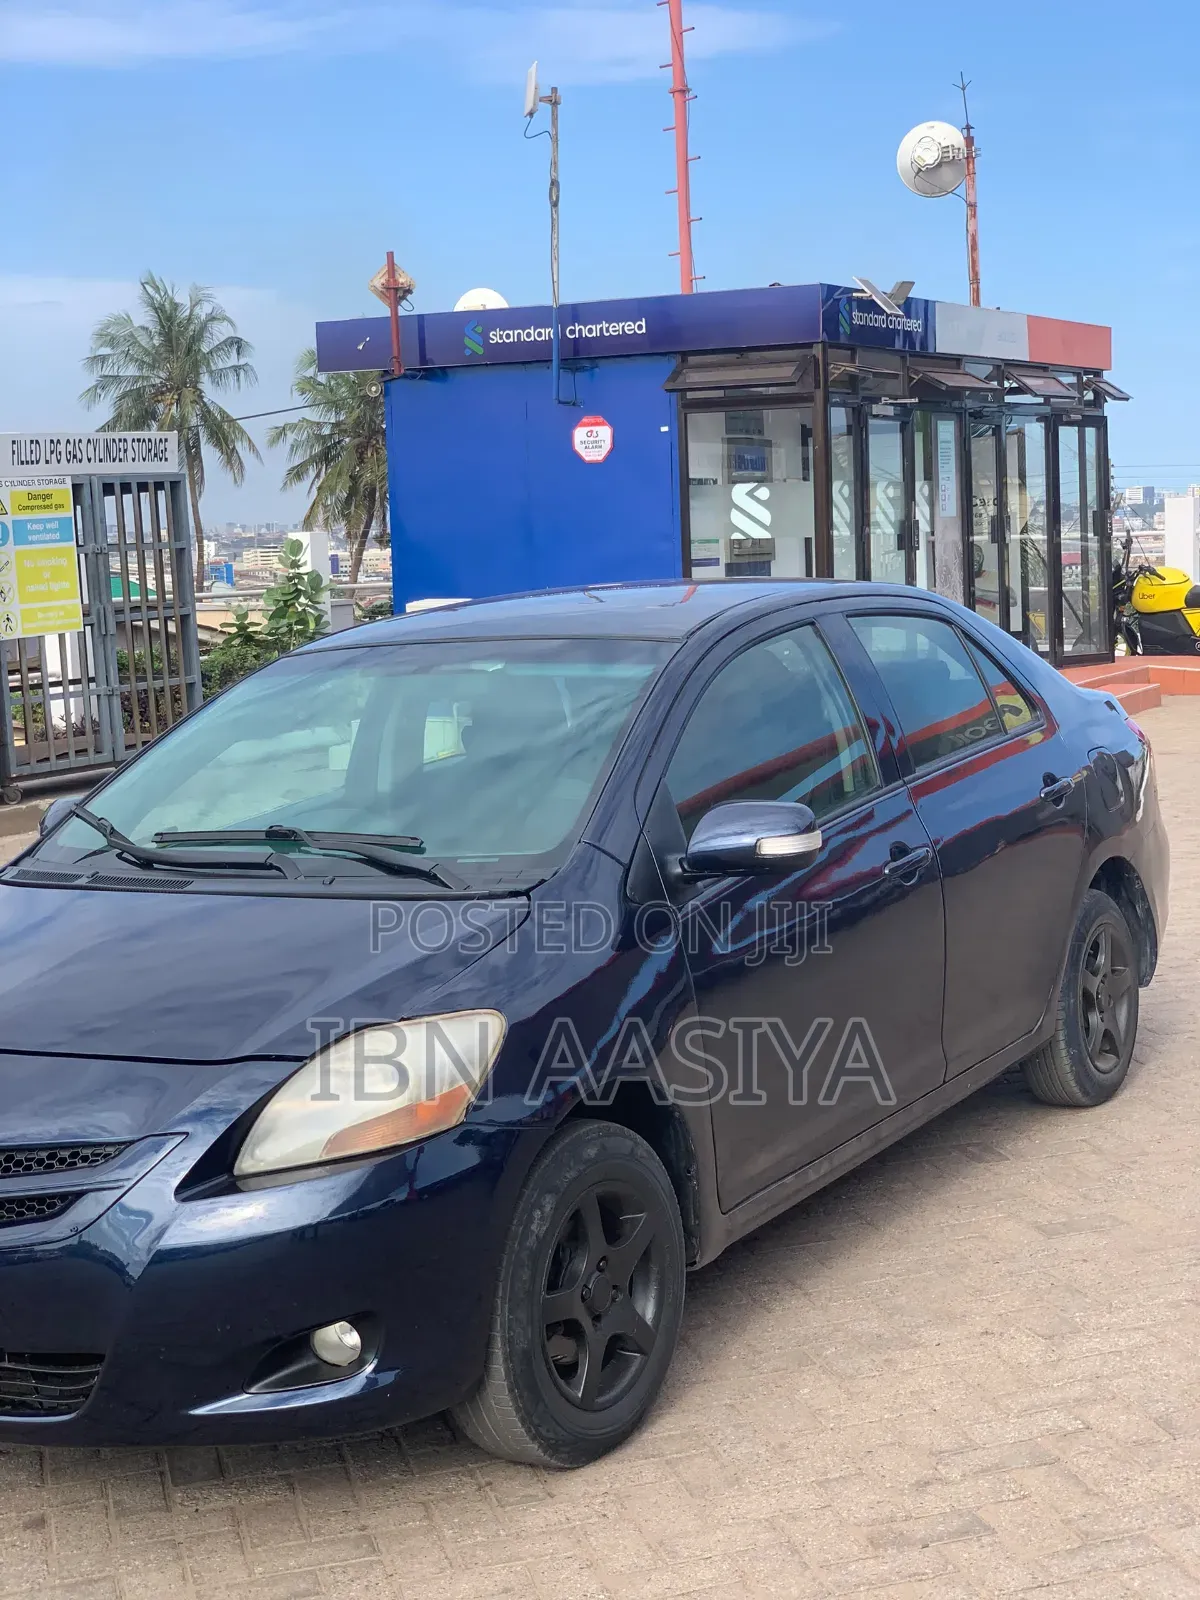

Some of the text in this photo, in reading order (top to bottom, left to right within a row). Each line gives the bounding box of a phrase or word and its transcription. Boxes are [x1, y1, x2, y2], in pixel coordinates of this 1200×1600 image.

[852, 309, 922, 332] standard chartered
[566, 318, 647, 339] chartered
[11, 437, 168, 466] FILLED LPG GAS CYLINDER STORAGE
[37, 478, 67, 486] STORAGE
[27, 492, 53, 502] Danger
[17, 503, 65, 512] Compressed gas
[27, 521, 59, 531] Keep well
[27, 532, 60, 541] ventilated
[1138, 592, 1156, 600] Uber
